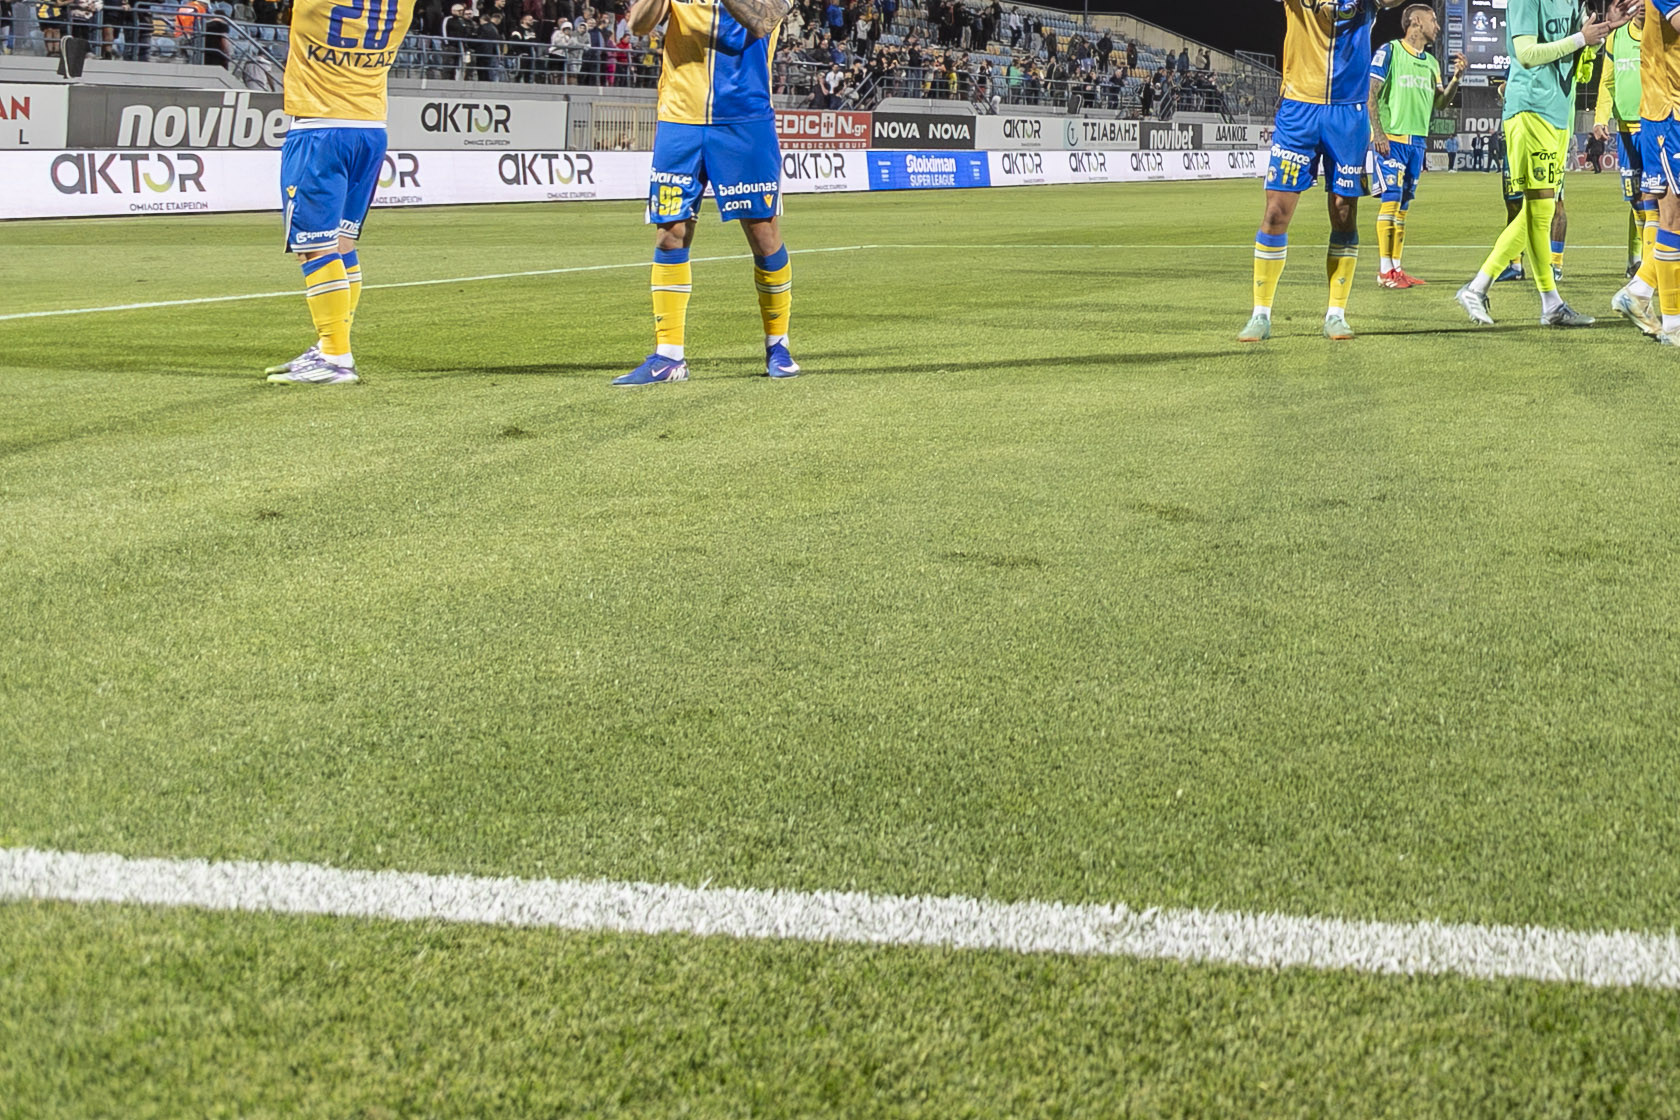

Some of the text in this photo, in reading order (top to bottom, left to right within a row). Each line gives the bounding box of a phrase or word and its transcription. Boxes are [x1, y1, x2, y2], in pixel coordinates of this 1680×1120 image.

[117, 91, 291, 148] novibe
[875, 121, 971, 140] NOVA NOVA
[1083, 122, 1138, 142] ΤΣΙΑΒΛΗΣ
[1150, 125, 1194, 150] novibet
[906, 154, 957, 173] Stoiximan
[718, 181, 777, 196] badounas
[910, 173, 955, 186] SUPER LEAGUE
[722, 199, 751, 212] .com
